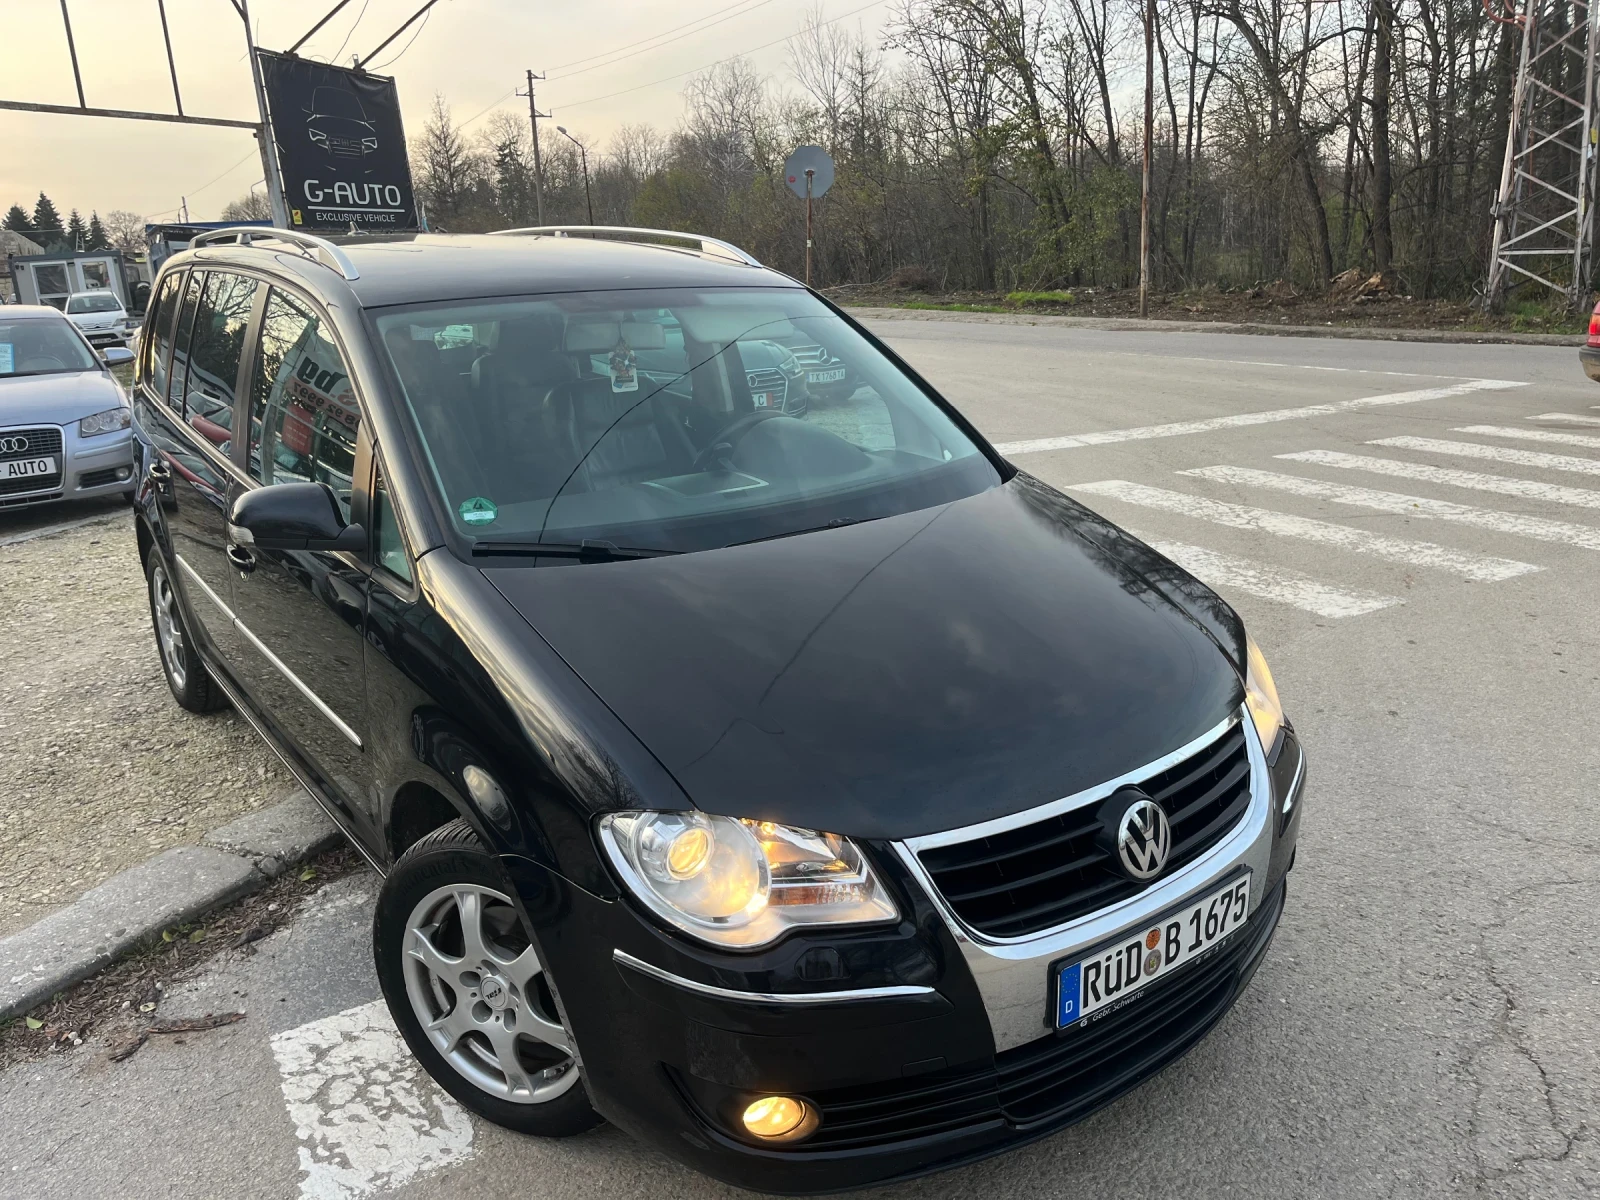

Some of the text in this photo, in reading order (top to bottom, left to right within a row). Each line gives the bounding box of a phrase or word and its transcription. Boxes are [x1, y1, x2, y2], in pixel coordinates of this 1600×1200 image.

[303, 179, 401, 206] G-AUTO
[316, 212, 396, 223] EXCLUSIVE VEHICLE
[8, 459, 48, 477] AUTO
[1065, 1000, 1073, 1014] D
[1083, 940, 1143, 1010] RÜD
[1164, 921, 1181, 967] B
[1188, 880, 1247, 953] 1675
